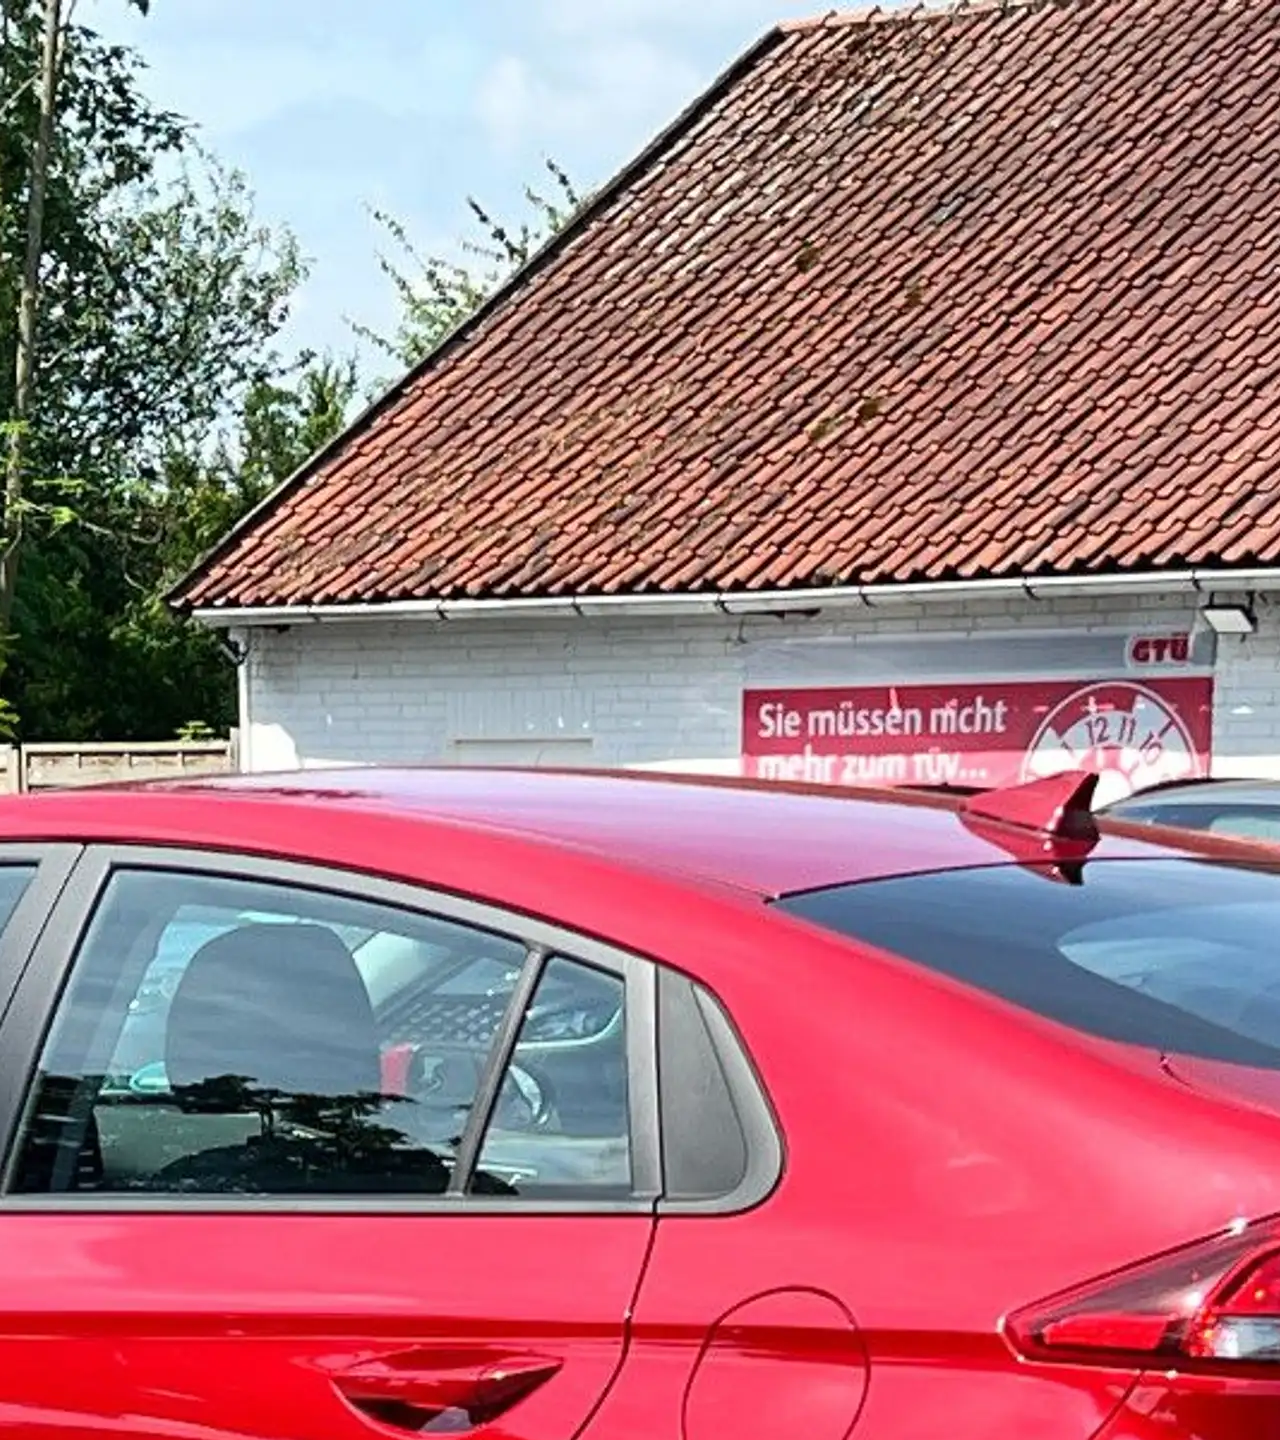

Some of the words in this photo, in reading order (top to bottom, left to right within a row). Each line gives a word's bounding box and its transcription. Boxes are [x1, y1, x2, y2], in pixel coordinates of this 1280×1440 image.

[1132, 632, 1188, 662] GTÜ
[758, 703, 801, 737] Sie
[808, 701, 921, 736] müssen
[930, 696, 1007, 734] nicht
[757, 743, 835, 782] mehr
[842, 753, 905, 780] zum
